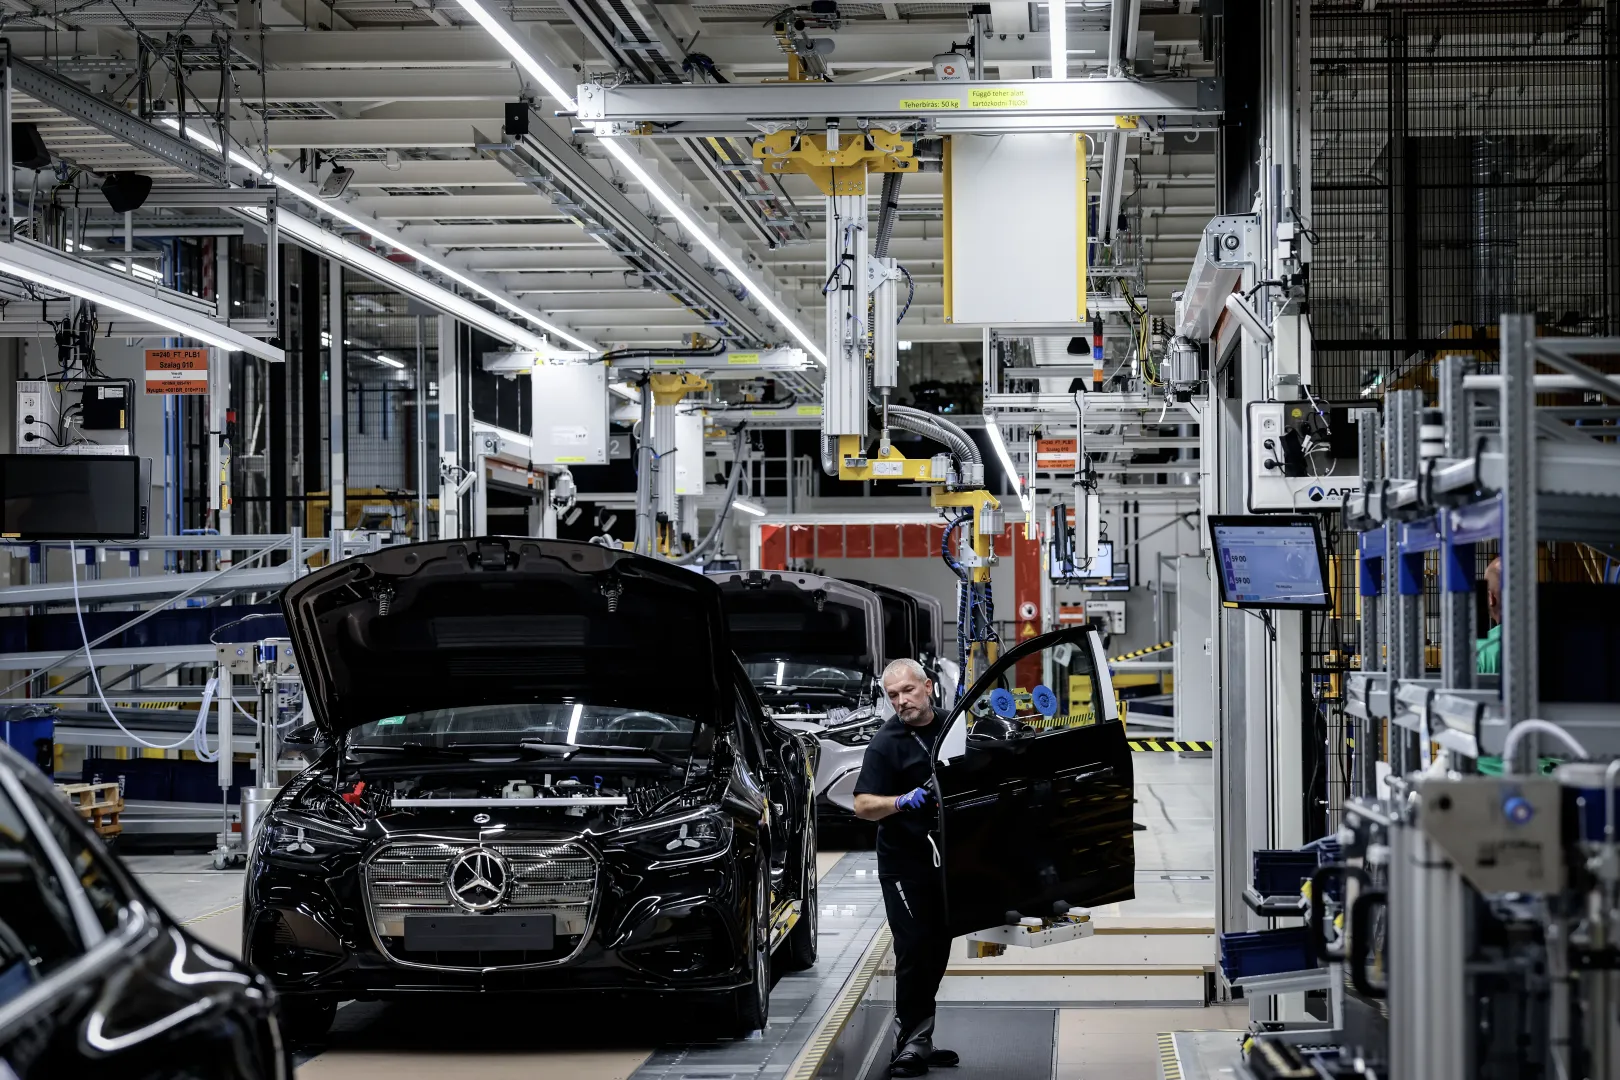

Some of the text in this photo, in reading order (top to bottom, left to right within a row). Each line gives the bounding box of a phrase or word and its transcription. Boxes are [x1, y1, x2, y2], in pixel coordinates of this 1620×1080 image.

[950, 101, 959, 109] kg
[159, 361, 181, 370] Szalag
[610, 439, 620, 455] 2
